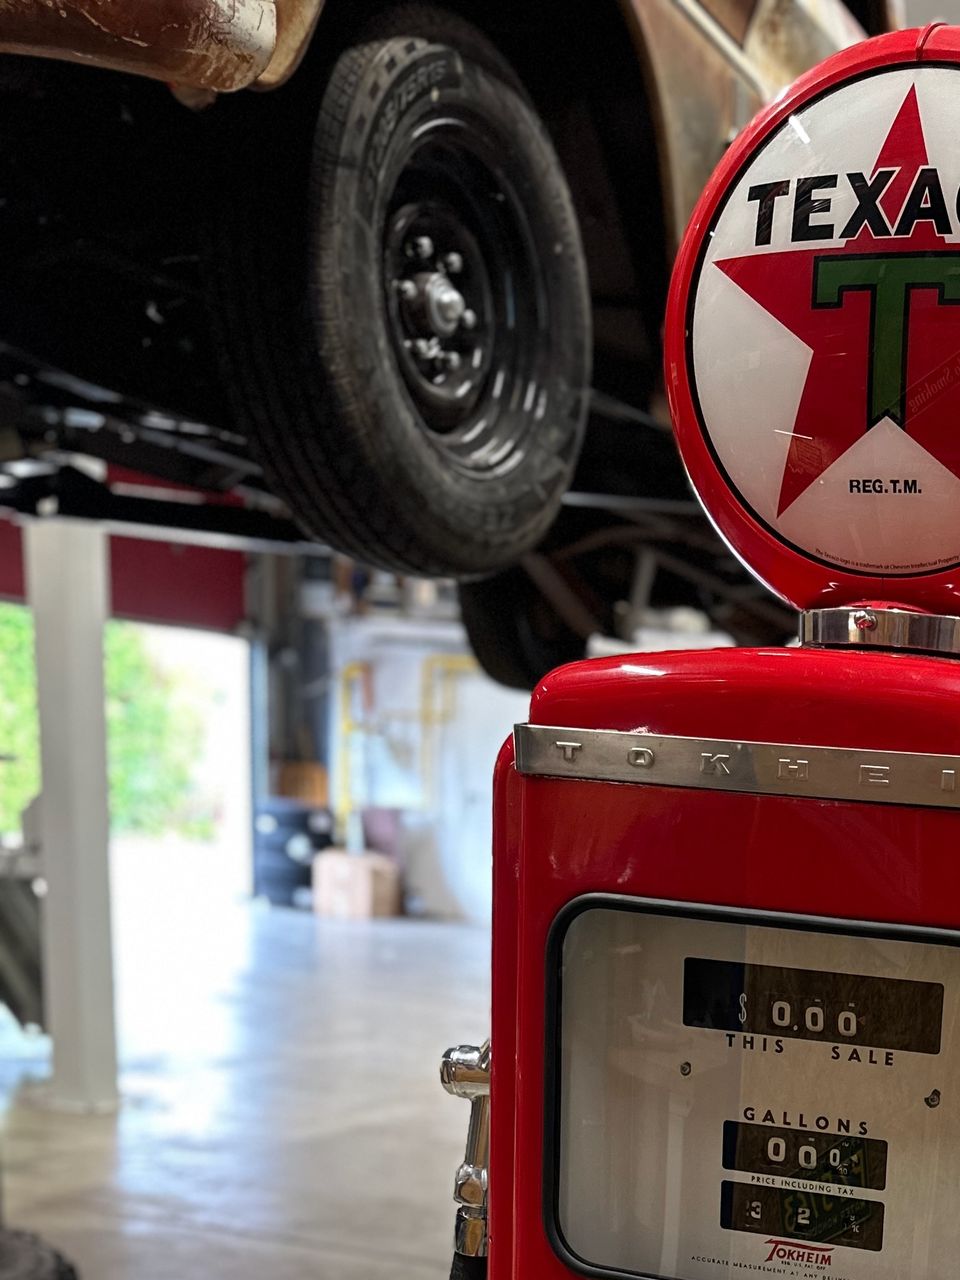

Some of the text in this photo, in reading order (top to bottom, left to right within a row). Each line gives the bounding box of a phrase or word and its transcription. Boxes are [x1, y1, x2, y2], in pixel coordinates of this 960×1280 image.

[725, 1033, 894, 1066] THIS SALE
[743, 1106, 869, 1136] GALLONS
[750, 1175, 855, 1197] PRICE INCLUDING TAX
[796, 1207, 811, 1225] 2
[764, 1238, 835, 1266] TOKHEIM
[691, 1255, 730, 1266] ACCURATE
[732, 1261, 786, 1275] MEASUREMENT
[803, 1272, 818, 1280] ANY
